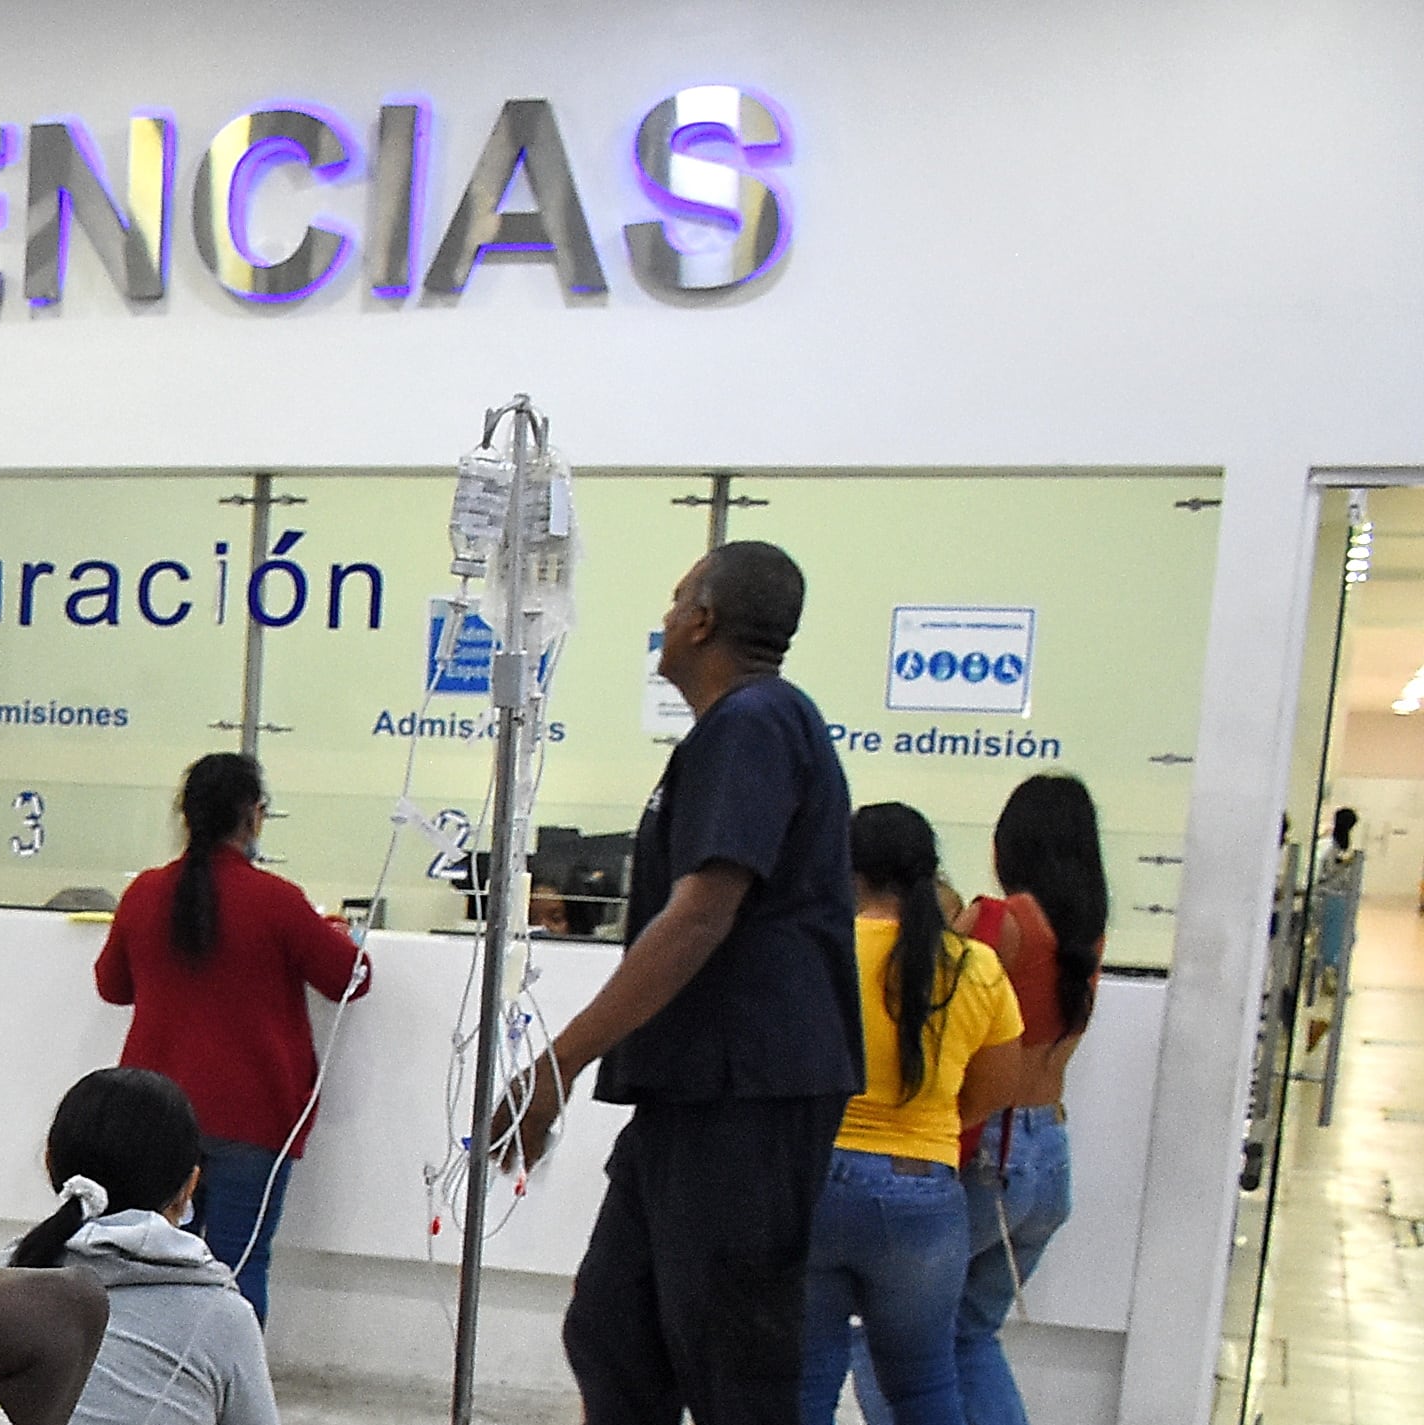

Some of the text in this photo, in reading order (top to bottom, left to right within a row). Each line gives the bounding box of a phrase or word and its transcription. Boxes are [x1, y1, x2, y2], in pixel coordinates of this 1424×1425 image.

[825, 723, 1062, 760] Pre admisión
[9, 790, 46, 858] 3
[424, 808, 471, 880] 2
